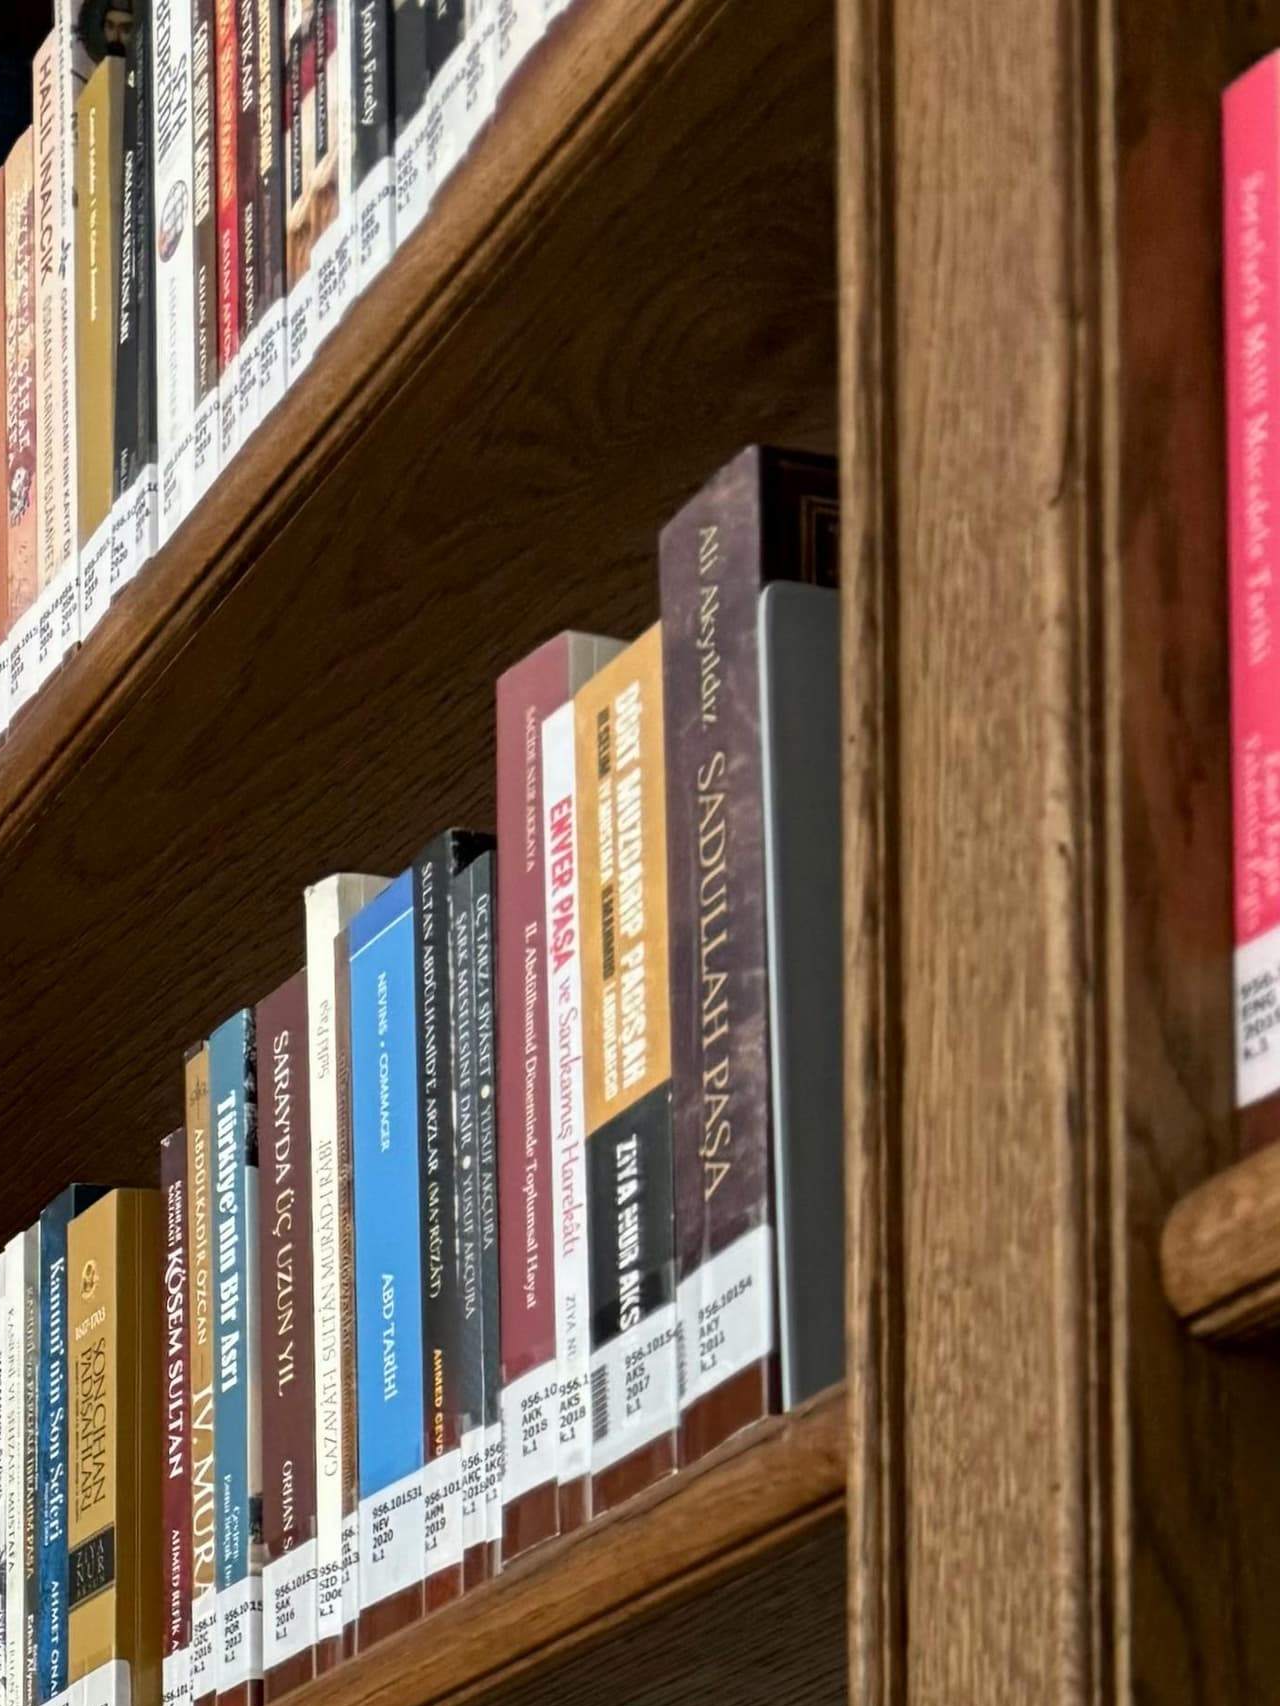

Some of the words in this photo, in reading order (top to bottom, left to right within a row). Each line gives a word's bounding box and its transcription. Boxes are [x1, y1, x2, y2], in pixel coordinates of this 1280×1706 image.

[361, 1, 375, 43] John
[362, 48, 377, 126] Freely
[698, 524, 719, 577] Ali
[699, 583, 723, 732] Akyıldız
[549, 793, 575, 889] ENVER
[552, 892, 578, 977] PAŞA
[697, 750, 730, 1056] SADULLAH
[558, 976, 571, 1002] ve
[273, 1029, 292, 1185] SARAY'DA
[557, 1006, 583, 1139] Sarıkamış
[699, 1062, 731, 1205] PAŞA
[215, 1088, 240, 1273] Türkiye'nin
[272, 1188, 293, 1237] ÜÇ
[560, 1141, 586, 1258] Harekâtı
[164, 1246, 184, 1358] KÖSEM
[220, 1282, 240, 1326] Bir
[277, 1241, 294, 1337] UZUN
[380, 1272, 395, 1322] ABD
[221, 1330, 241, 1396] Asrı
[278, 1341, 295, 1399] YIL
[381, 1325, 399, 1403] TARİHİ
[167, 1366, 185, 1479] SULTAN
